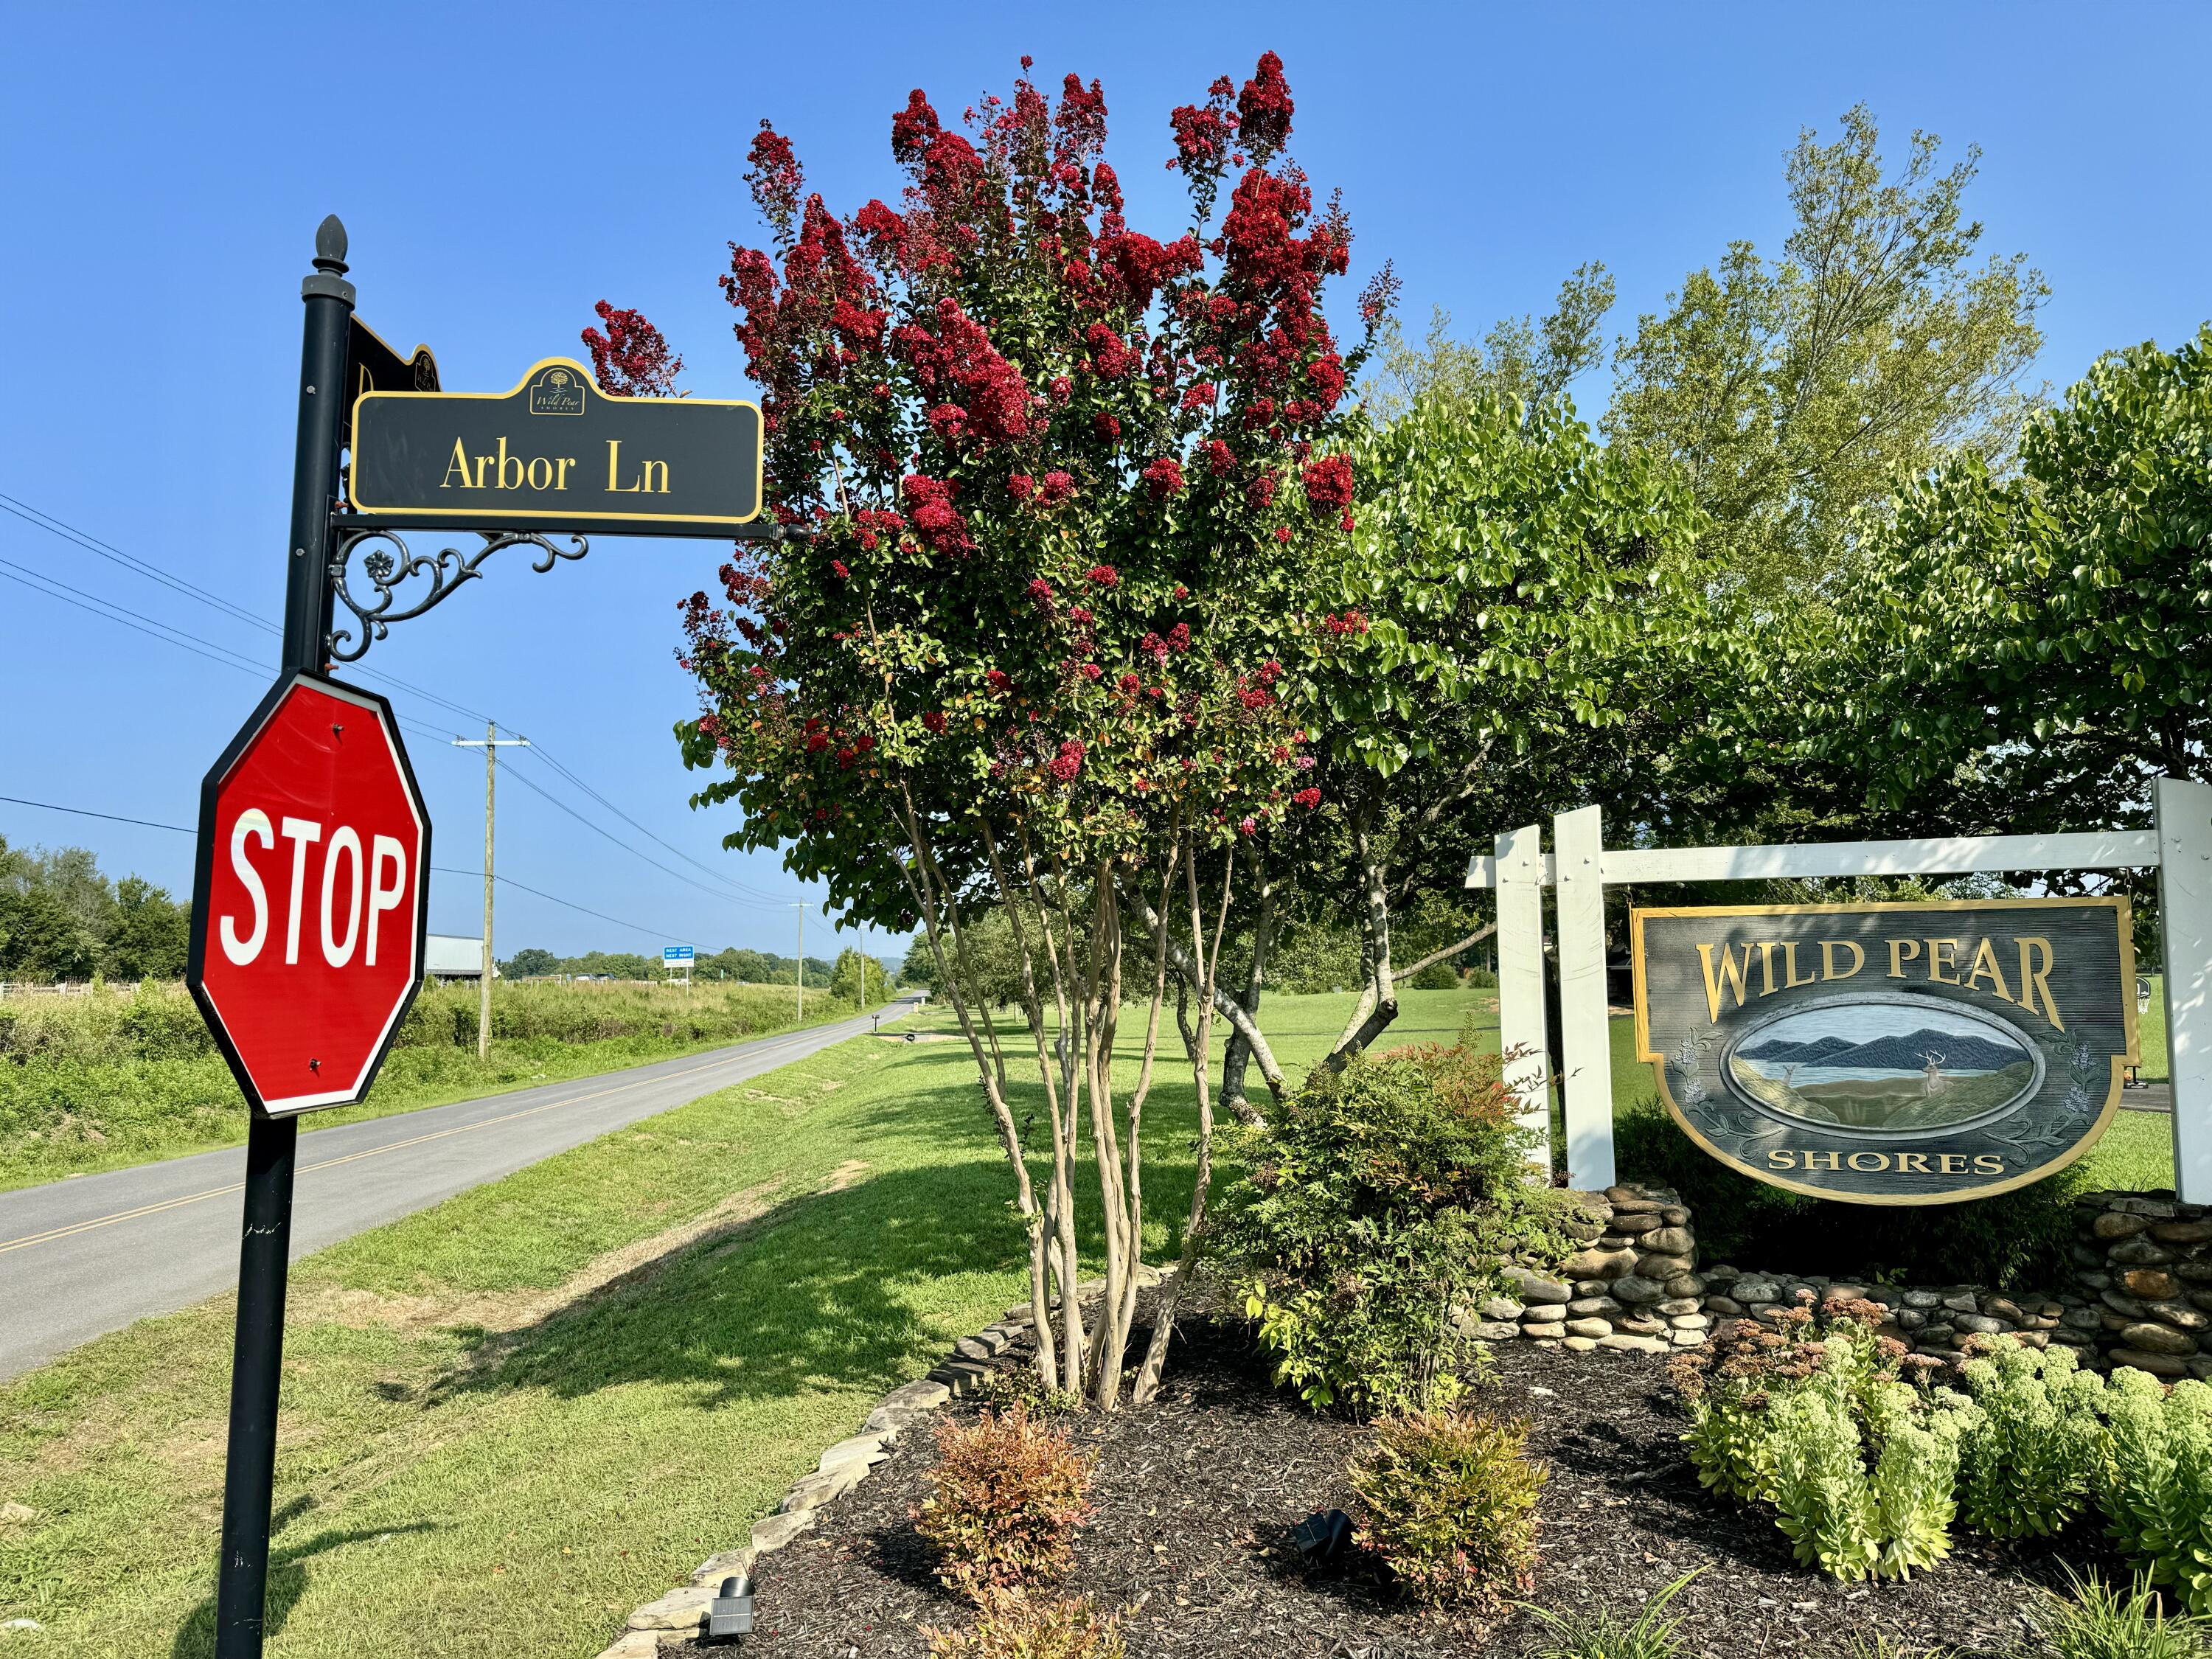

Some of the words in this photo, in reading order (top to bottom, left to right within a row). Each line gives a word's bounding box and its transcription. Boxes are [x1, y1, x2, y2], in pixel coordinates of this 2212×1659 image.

[537, 393, 566, 406] Wild
[560, 397, 580, 406] Pear
[439, 436, 576, 490] Arbor
[604, 439, 672, 493] Ln
[220, 807, 407, 968] STOP
[1695, 940, 1866, 1024] WILD
[1884, 936, 2066, 1033] PEAR
[1767, 1150, 2006, 1176] SHORES
